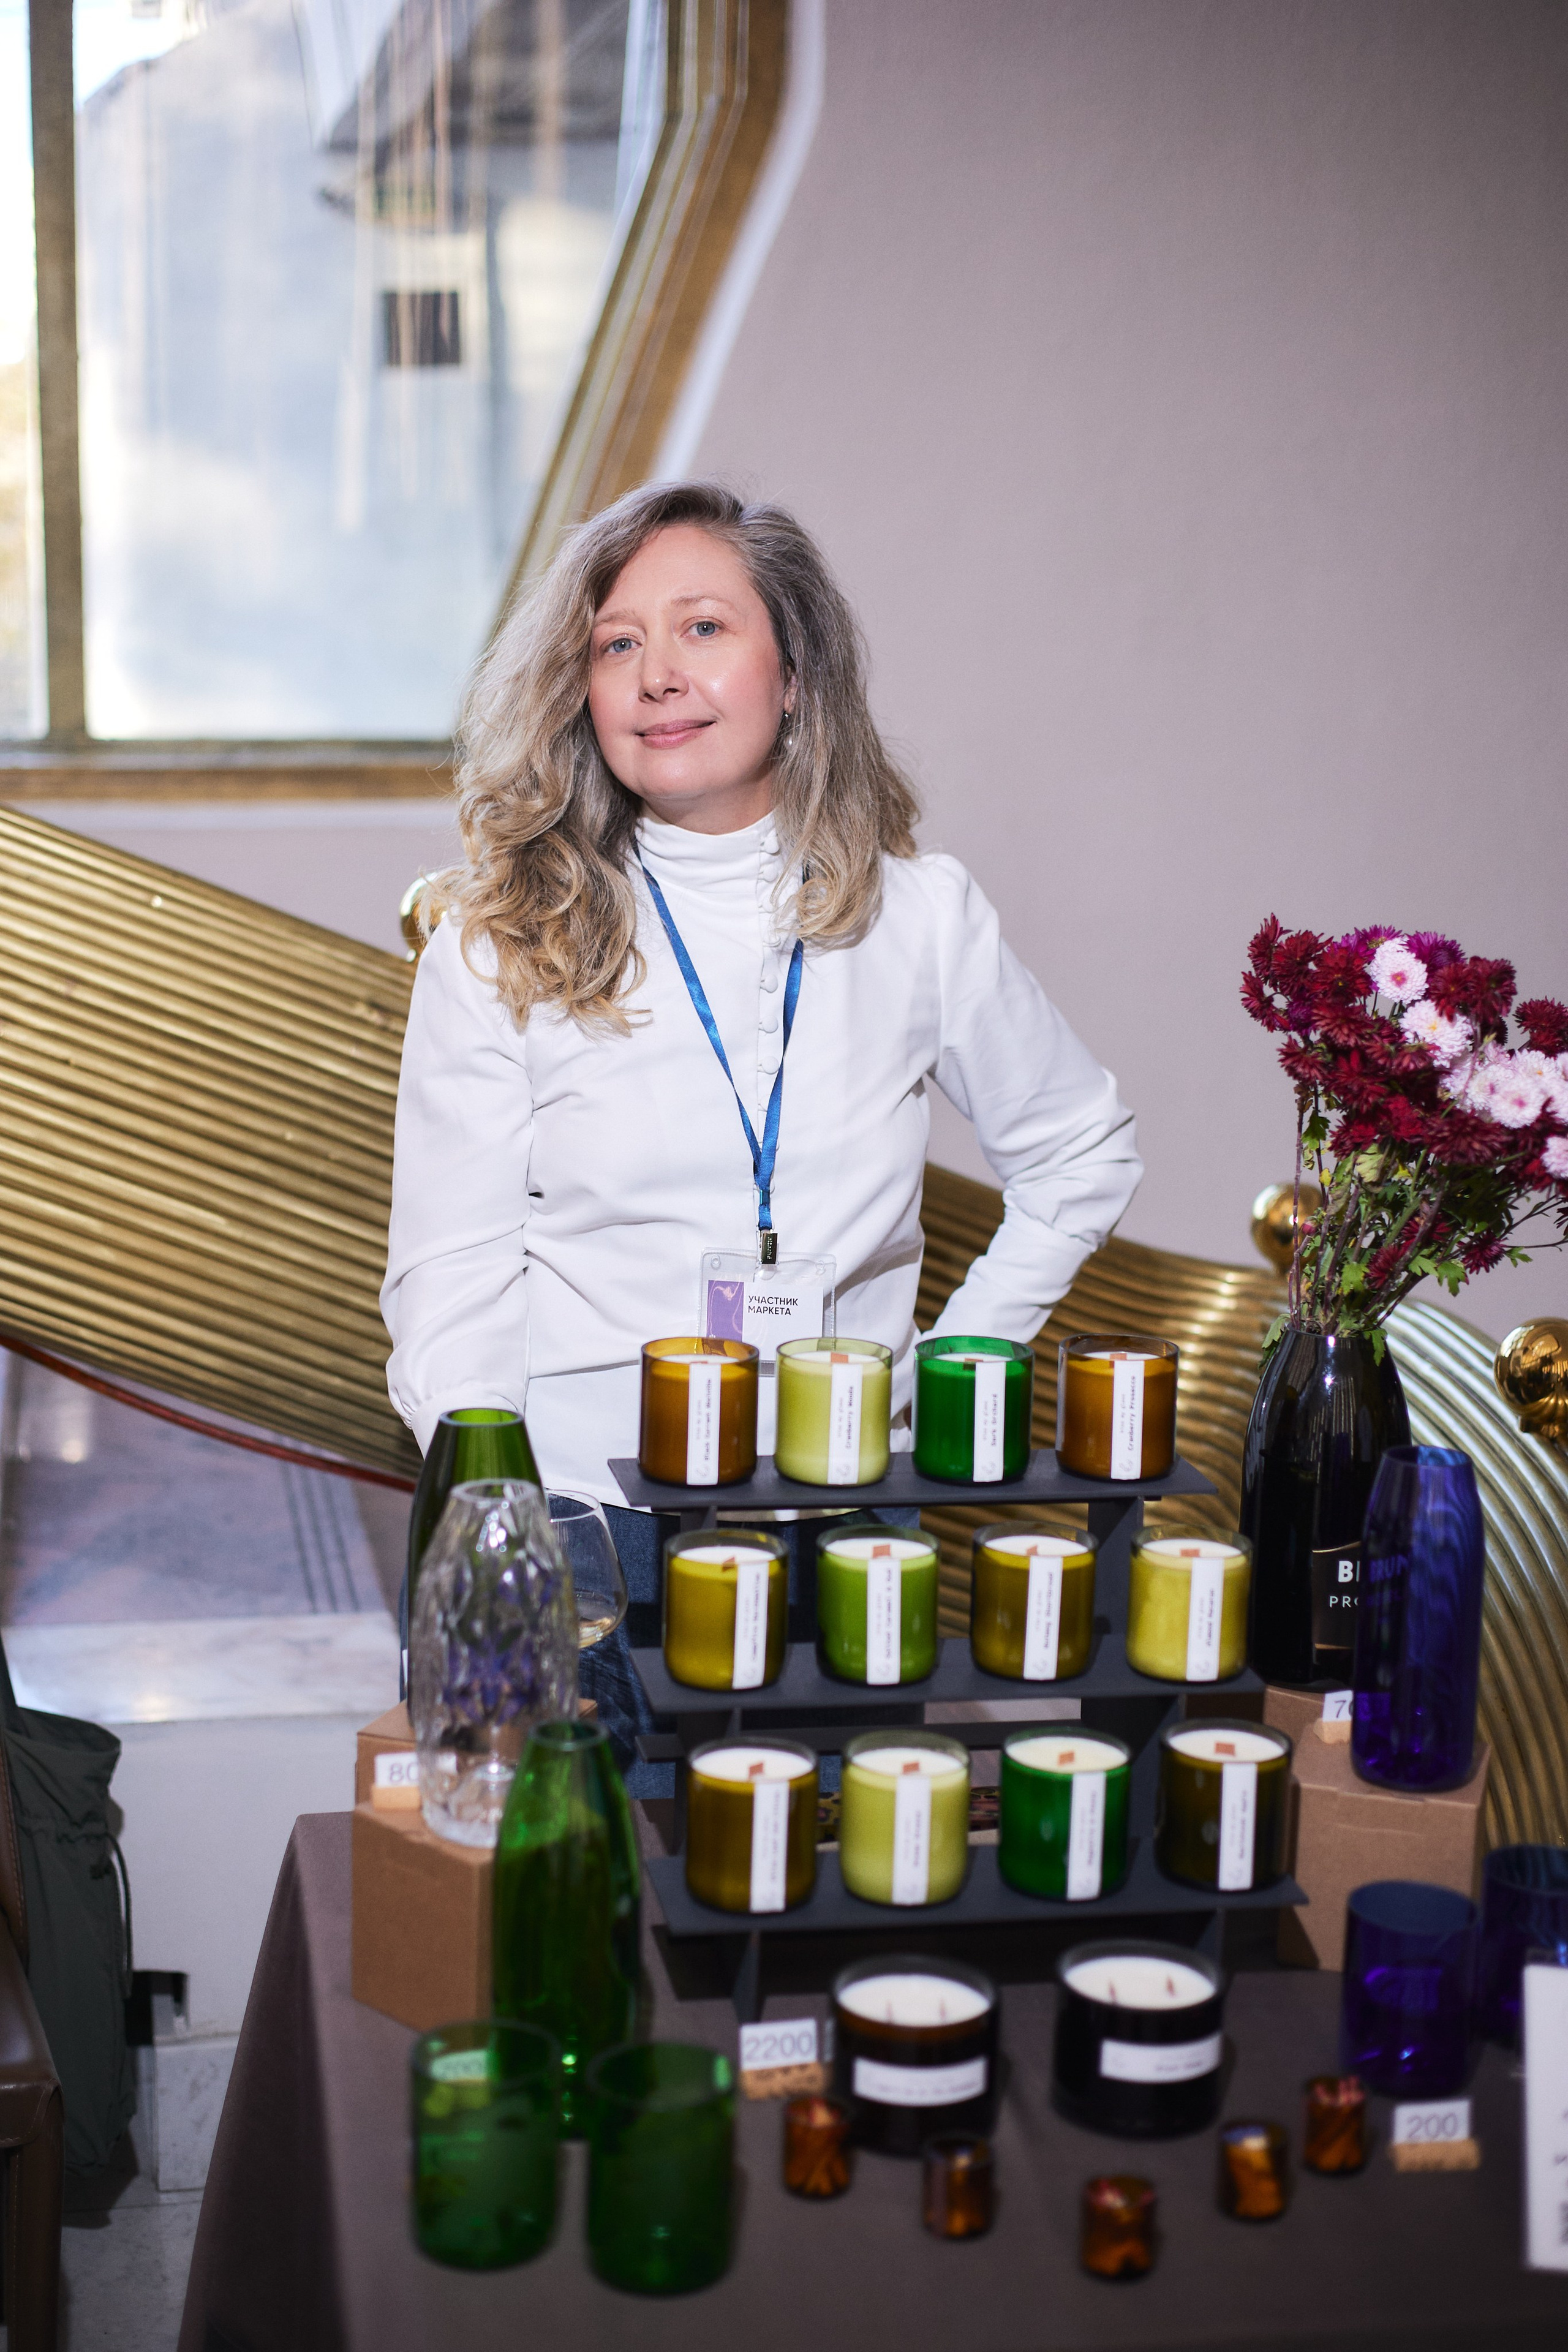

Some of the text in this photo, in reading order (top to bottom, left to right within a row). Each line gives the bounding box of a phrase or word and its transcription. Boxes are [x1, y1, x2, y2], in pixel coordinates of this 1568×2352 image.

[747, 1305, 792, 1316] МАРКЕТА
[748, 1295, 799, 1306] УЧАСТНИК
[1127, 1413, 1136, 1451] Cranberry
[745, 2030, 814, 2062] 2200
[1406, 2113, 1458, 2141] 200
